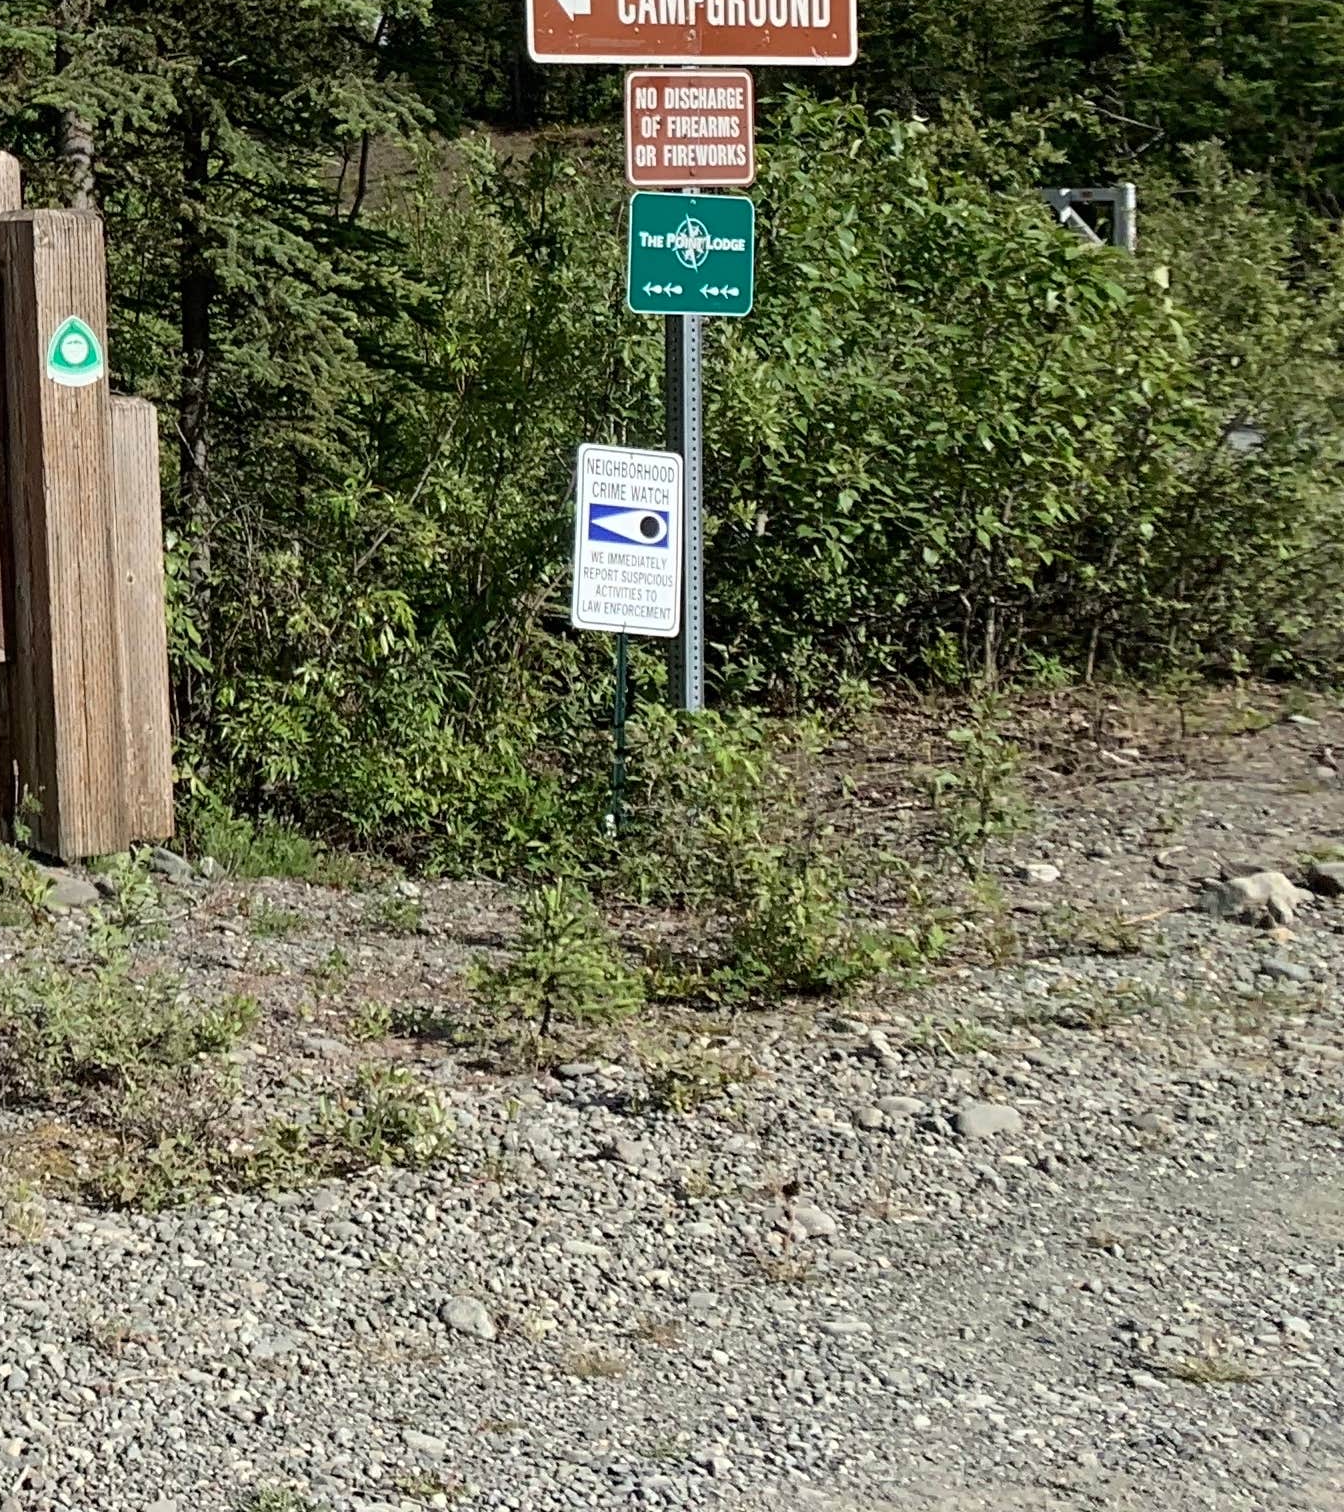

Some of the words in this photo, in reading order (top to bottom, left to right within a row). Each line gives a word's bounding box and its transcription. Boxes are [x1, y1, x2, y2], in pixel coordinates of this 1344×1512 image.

[635, 87, 657, 110] NO
[664, 87, 744, 110] DISCHARGE
[641, 115, 660, 138] OF
[667, 116, 740, 138] FIREARMS
[635, 145, 656, 167] OR
[664, 144, 746, 167] FIREWORKS
[639, 231, 664, 248] THE
[705, 234, 746, 251] LODGE
[587, 458, 674, 483] NEIGHBORHOOD
[592, 481, 627, 501] CRIME
[631, 485, 670, 505] WATCH
[591, 551, 604, 564] WE
[607, 553, 668, 570] IMMEDIATELY
[584, 566, 619, 581] REPORT
[621, 570, 673, 587] SUSPICIOUS
[595, 584, 642, 601] ACTIVITIES
[645, 589, 658, 603] TO
[582, 599, 602, 613] LAW
[604, 601, 672, 620] ENFORCEMENT
